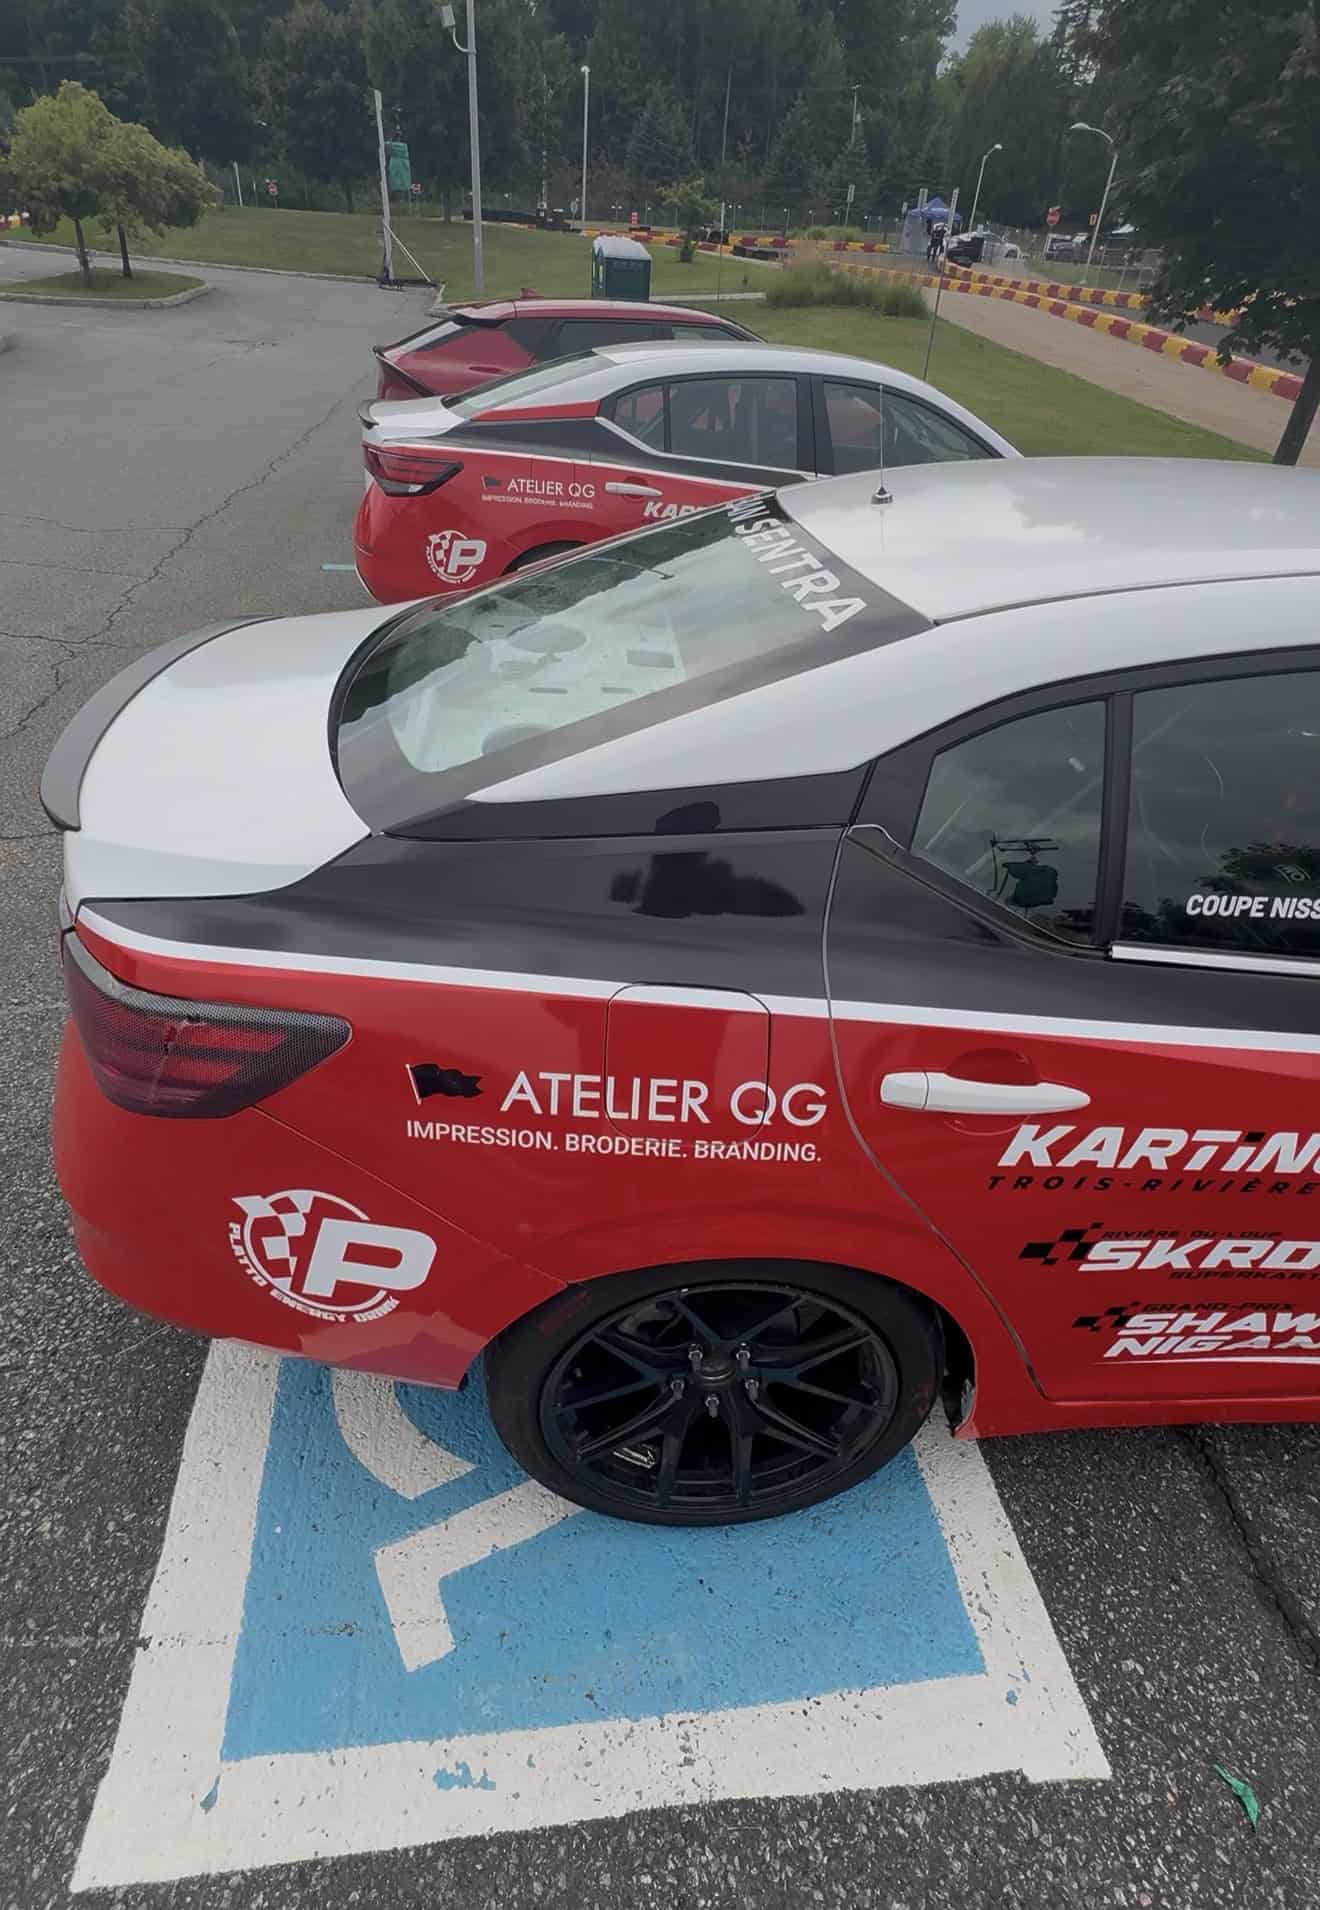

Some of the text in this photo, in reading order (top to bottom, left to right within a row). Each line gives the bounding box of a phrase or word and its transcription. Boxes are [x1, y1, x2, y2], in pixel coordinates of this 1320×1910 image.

[507, 478, 596, 498] ATELIER QG
[735, 518, 867, 632] SENTRA
[1186, 894, 1268, 917] COUPE
[500, 1071, 827, 1127] ATELIER QG
[406, 1119, 822, 1163] IMPRESSION. BRODERIE. BRANDING.
[997, 1124, 1320, 1174] KARTiN
